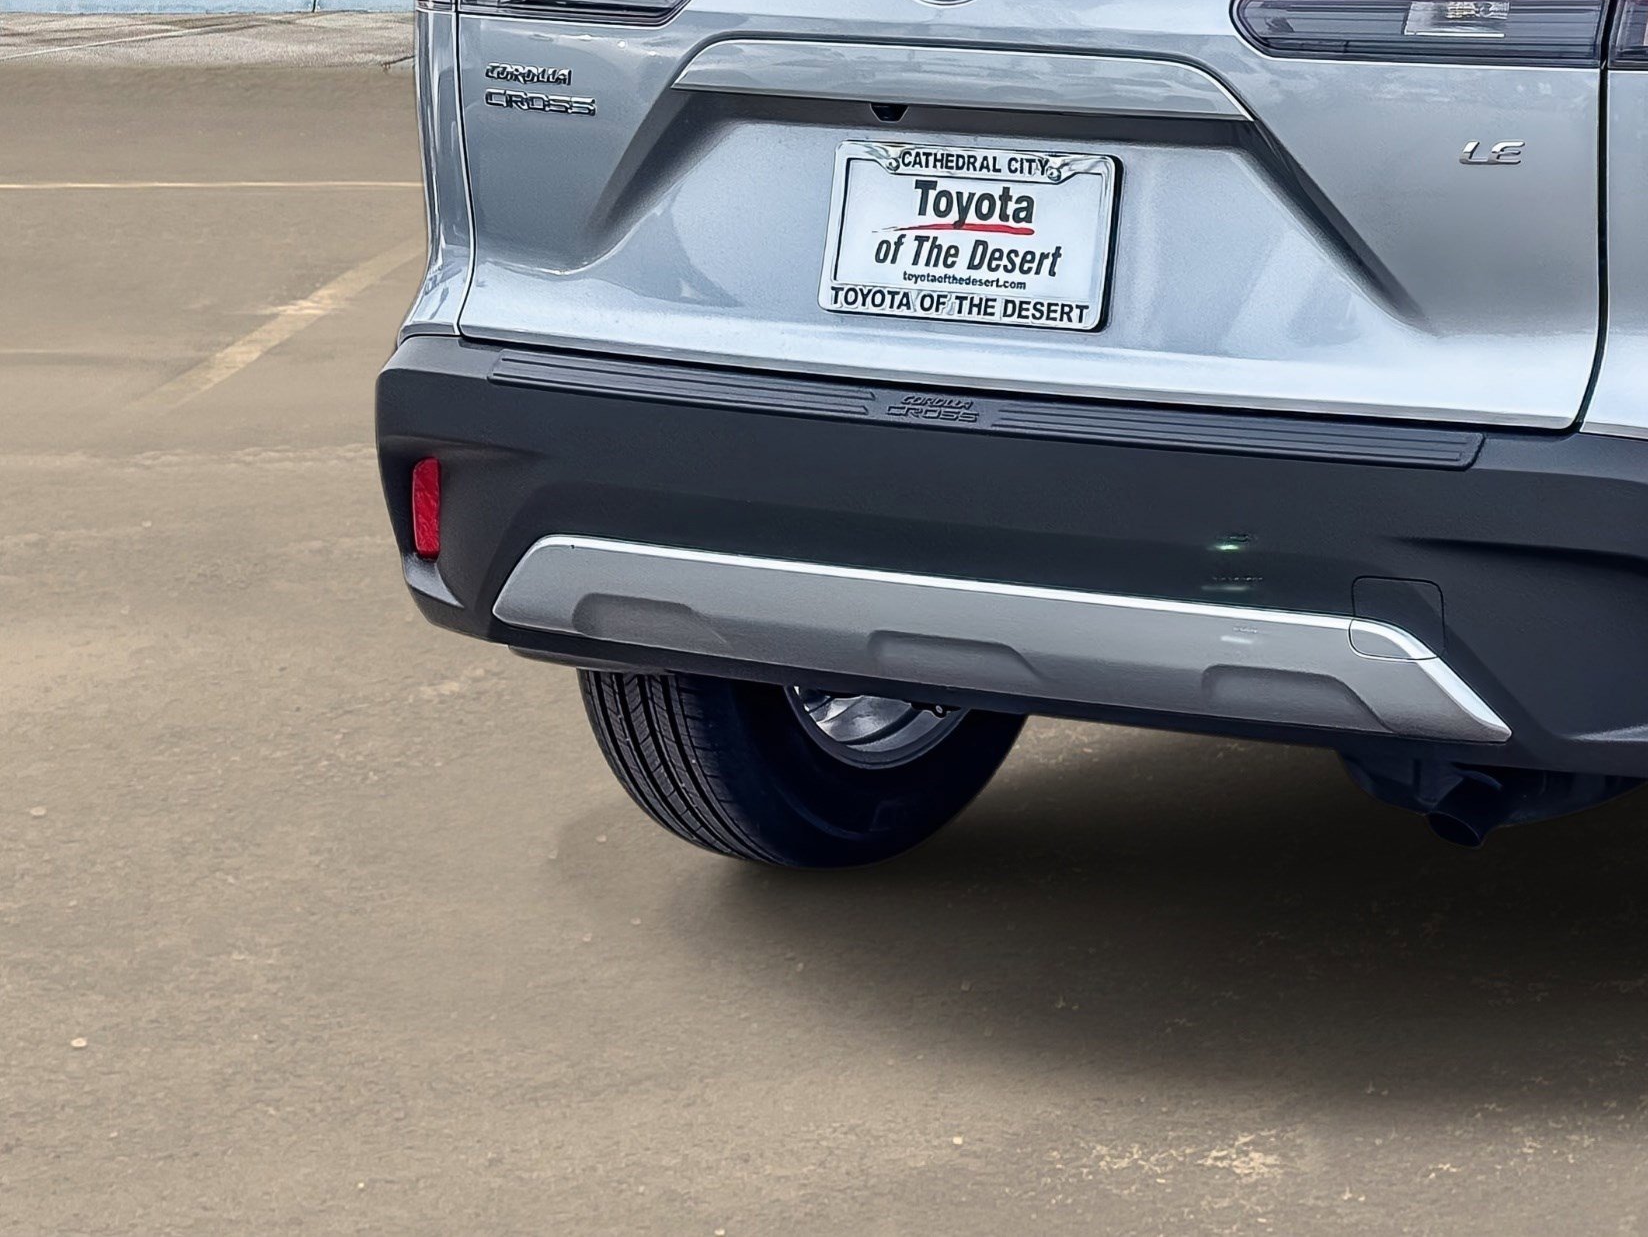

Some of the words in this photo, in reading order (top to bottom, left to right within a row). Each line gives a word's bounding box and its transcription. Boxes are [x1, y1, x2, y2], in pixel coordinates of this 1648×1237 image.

[484, 88, 597, 117] CROSS
[901, 150, 1002, 173] CATHEDRAL
[1007, 156, 1049, 177] CITY
[1459, 140, 1526, 166] LE
[914, 179, 1035, 229] Toyota
[874, 233, 906, 266] of
[912, 234, 960, 270] The
[966, 239, 1062, 278] Desert
[902, 269, 1027, 291] toyotaofthedesert.com
[831, 286, 913, 311] TOYOTA
[919, 292, 948, 313] OF
[954, 295, 998, 317] THE
[1001, 300, 1090, 325] DESERT
[886, 405, 980, 423] CROSS
